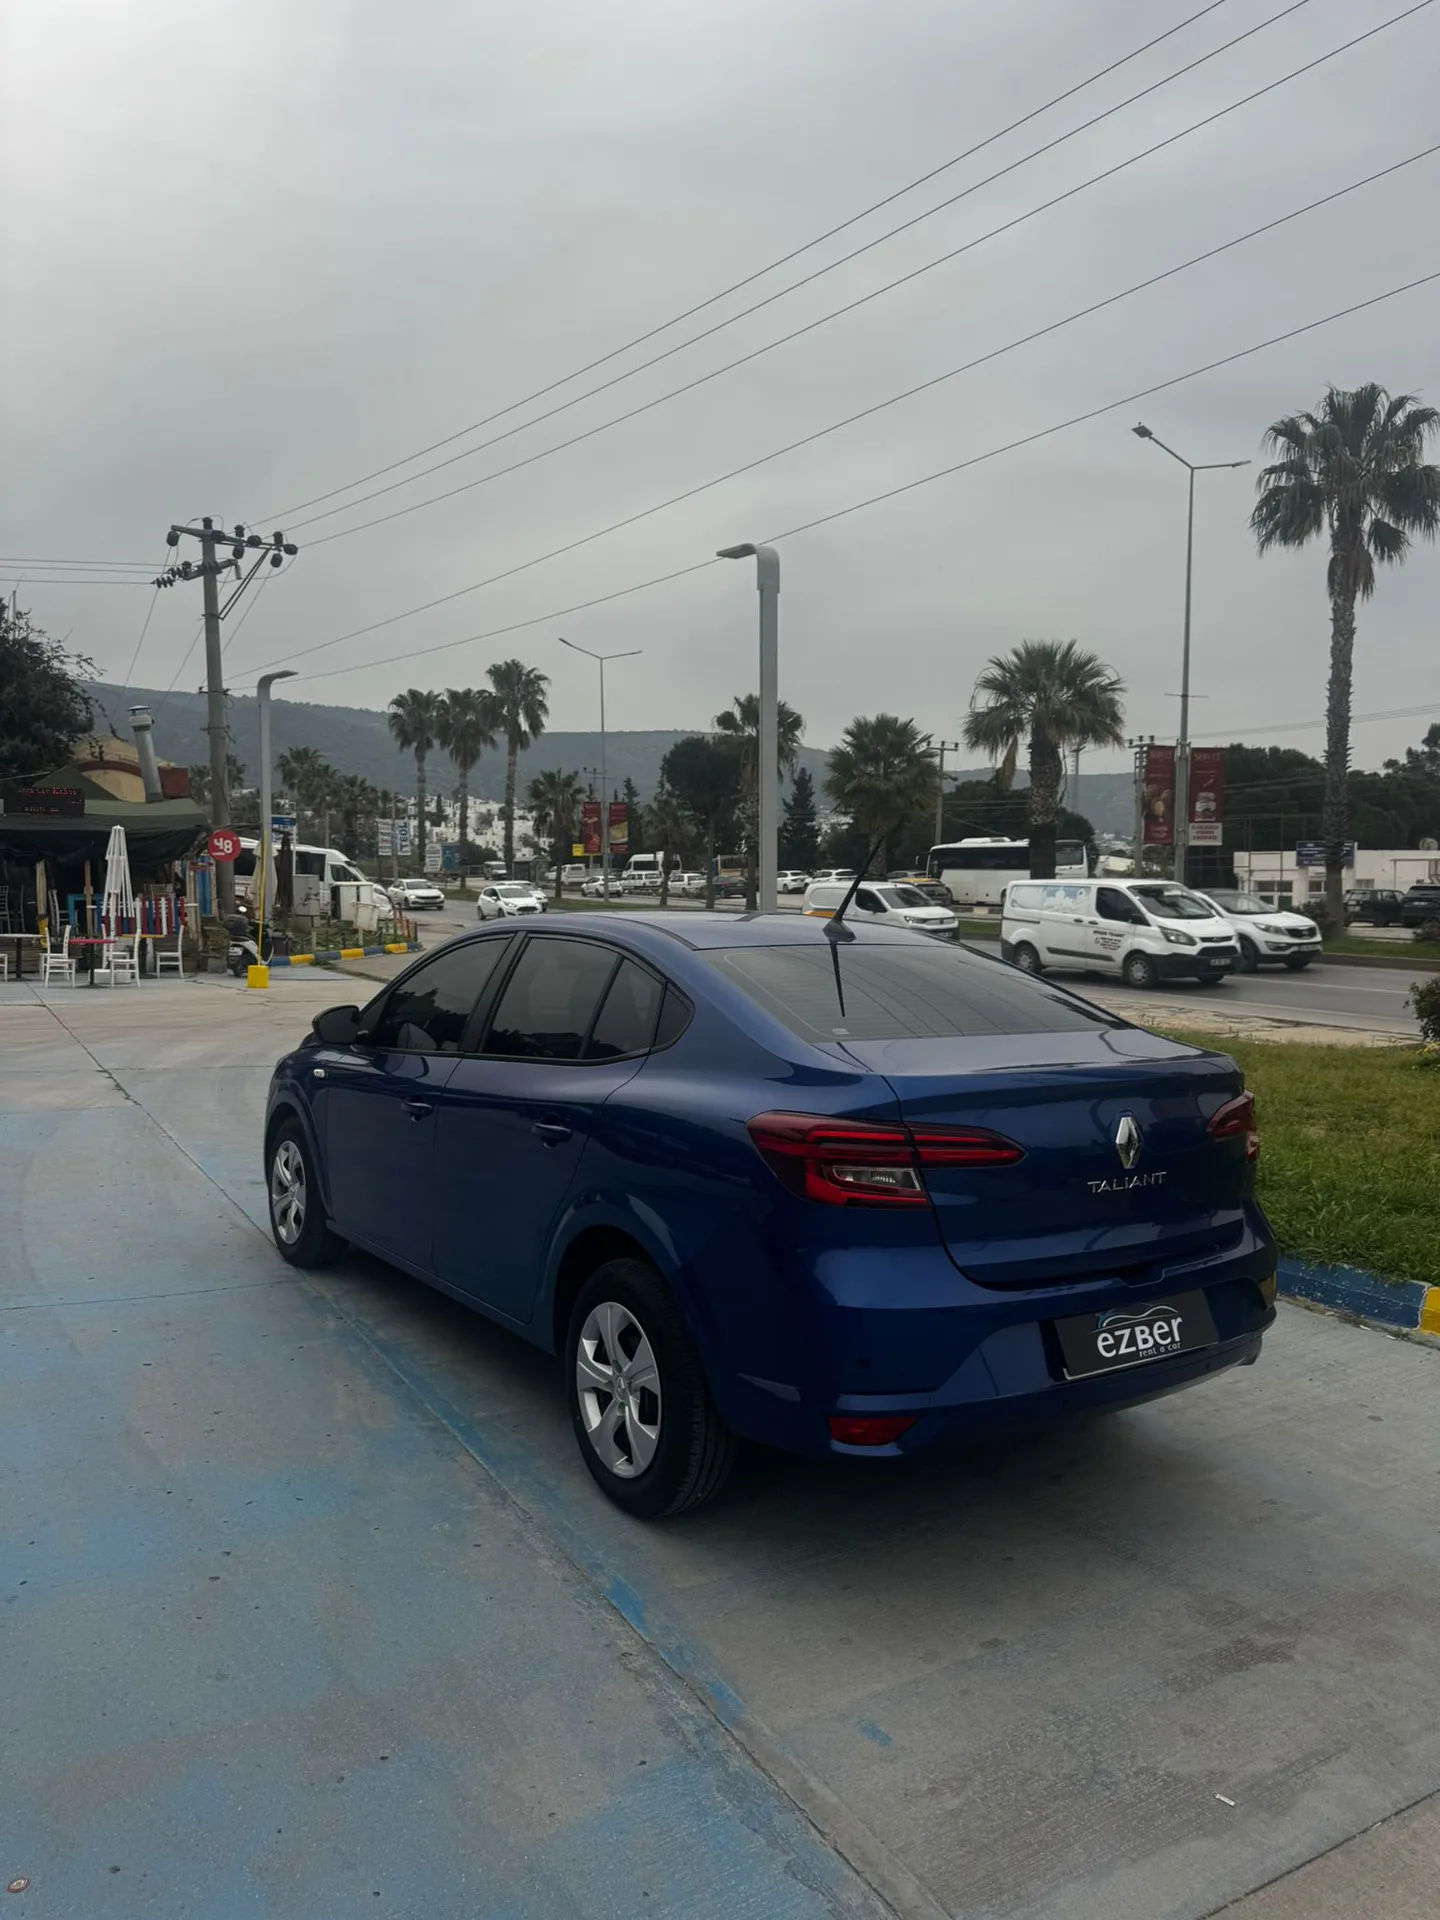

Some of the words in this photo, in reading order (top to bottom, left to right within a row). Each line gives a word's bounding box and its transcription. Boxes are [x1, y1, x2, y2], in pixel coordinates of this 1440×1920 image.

[214, 837, 233, 854] 48
[1087, 1172, 1167, 1193] TALIANT
[1139, 1347, 1157, 1358] rent
[1160, 1344, 1166, 1353] a
[1167, 1342, 1182, 1351] car
